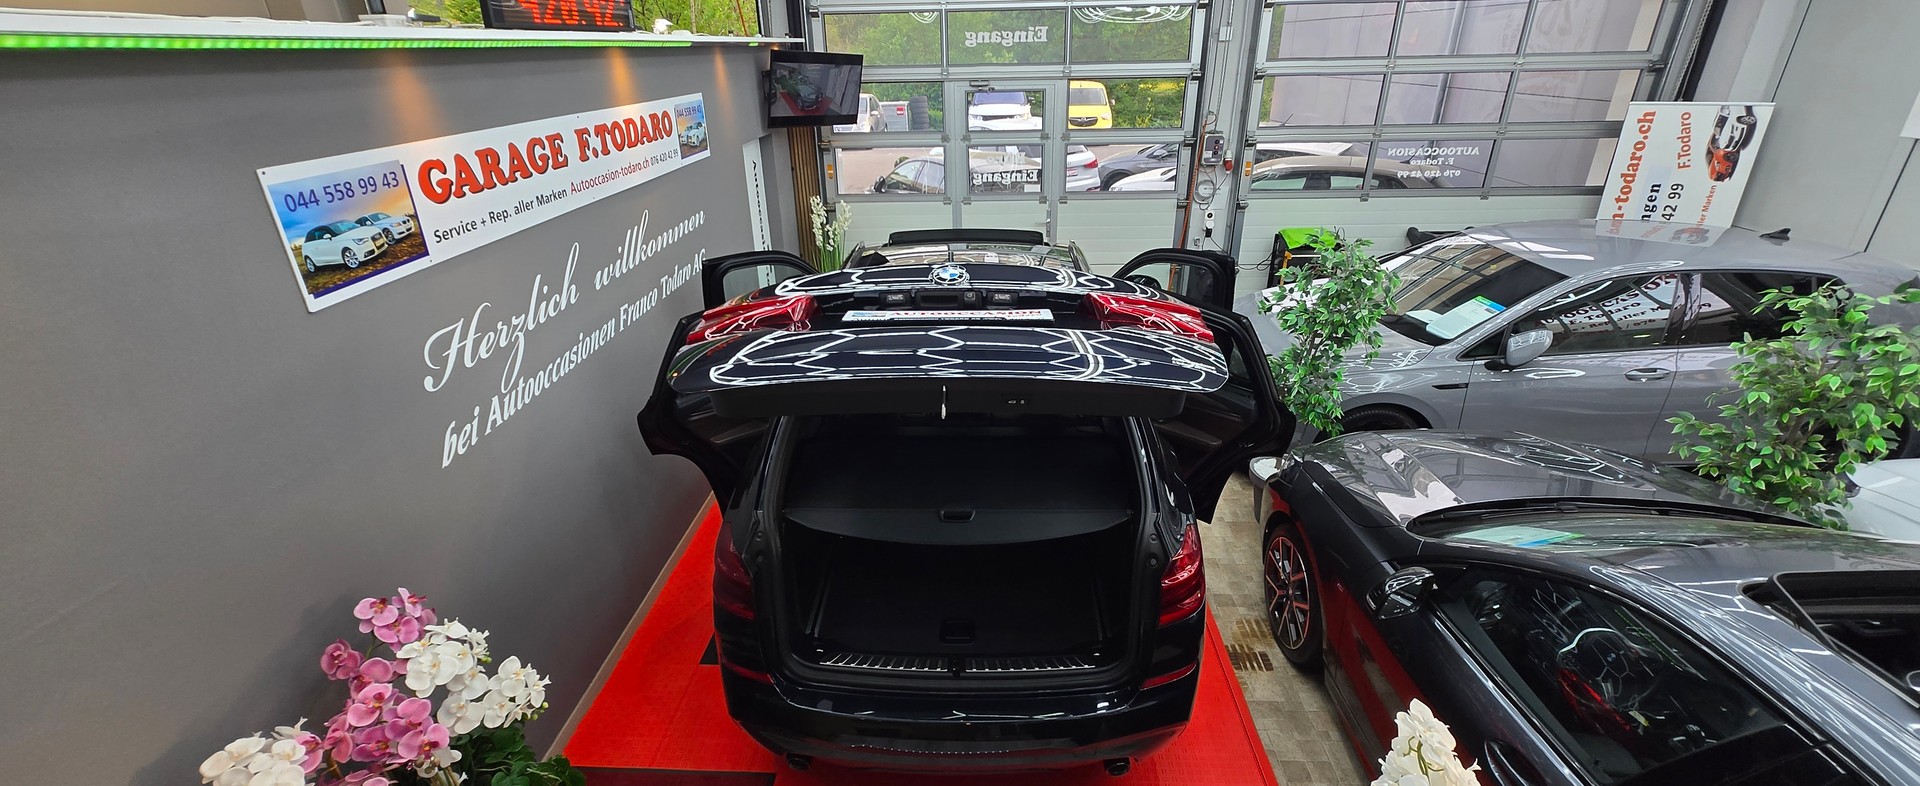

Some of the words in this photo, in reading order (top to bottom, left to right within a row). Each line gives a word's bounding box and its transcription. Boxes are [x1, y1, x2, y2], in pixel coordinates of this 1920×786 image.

[417, 132, 568, 204] GARAGE
[574, 110, 673, 162] F.TODARO
[1676, 111, 1691, 169] F.Todaro
[284, 189, 320, 212] 044
[322, 181, 355, 203] 558
[358, 176, 377, 195] 99
[382, 171, 399, 189] 43
[433, 220, 478, 243] Service
[480, 218, 487, 227] +
[488, 209, 512, 224] Rep.
[513, 199, 534, 215] aller
[536, 188, 568, 207] Marken
[570, 157, 650, 195] Autooccasion-todaro.ch
[1667, 183, 1684, 200] 99
[1701, 184, 1717, 212] Marken
[423, 242, 580, 392] Herzlich
[594, 209, 706, 290] willkommen
[442, 405, 480, 468] bei
[485, 317, 616, 435] Autooccasionen
[619, 287, 658, 333] Franco
[660, 264, 692, 299] Todaro
[692, 248, 706, 275] AG
